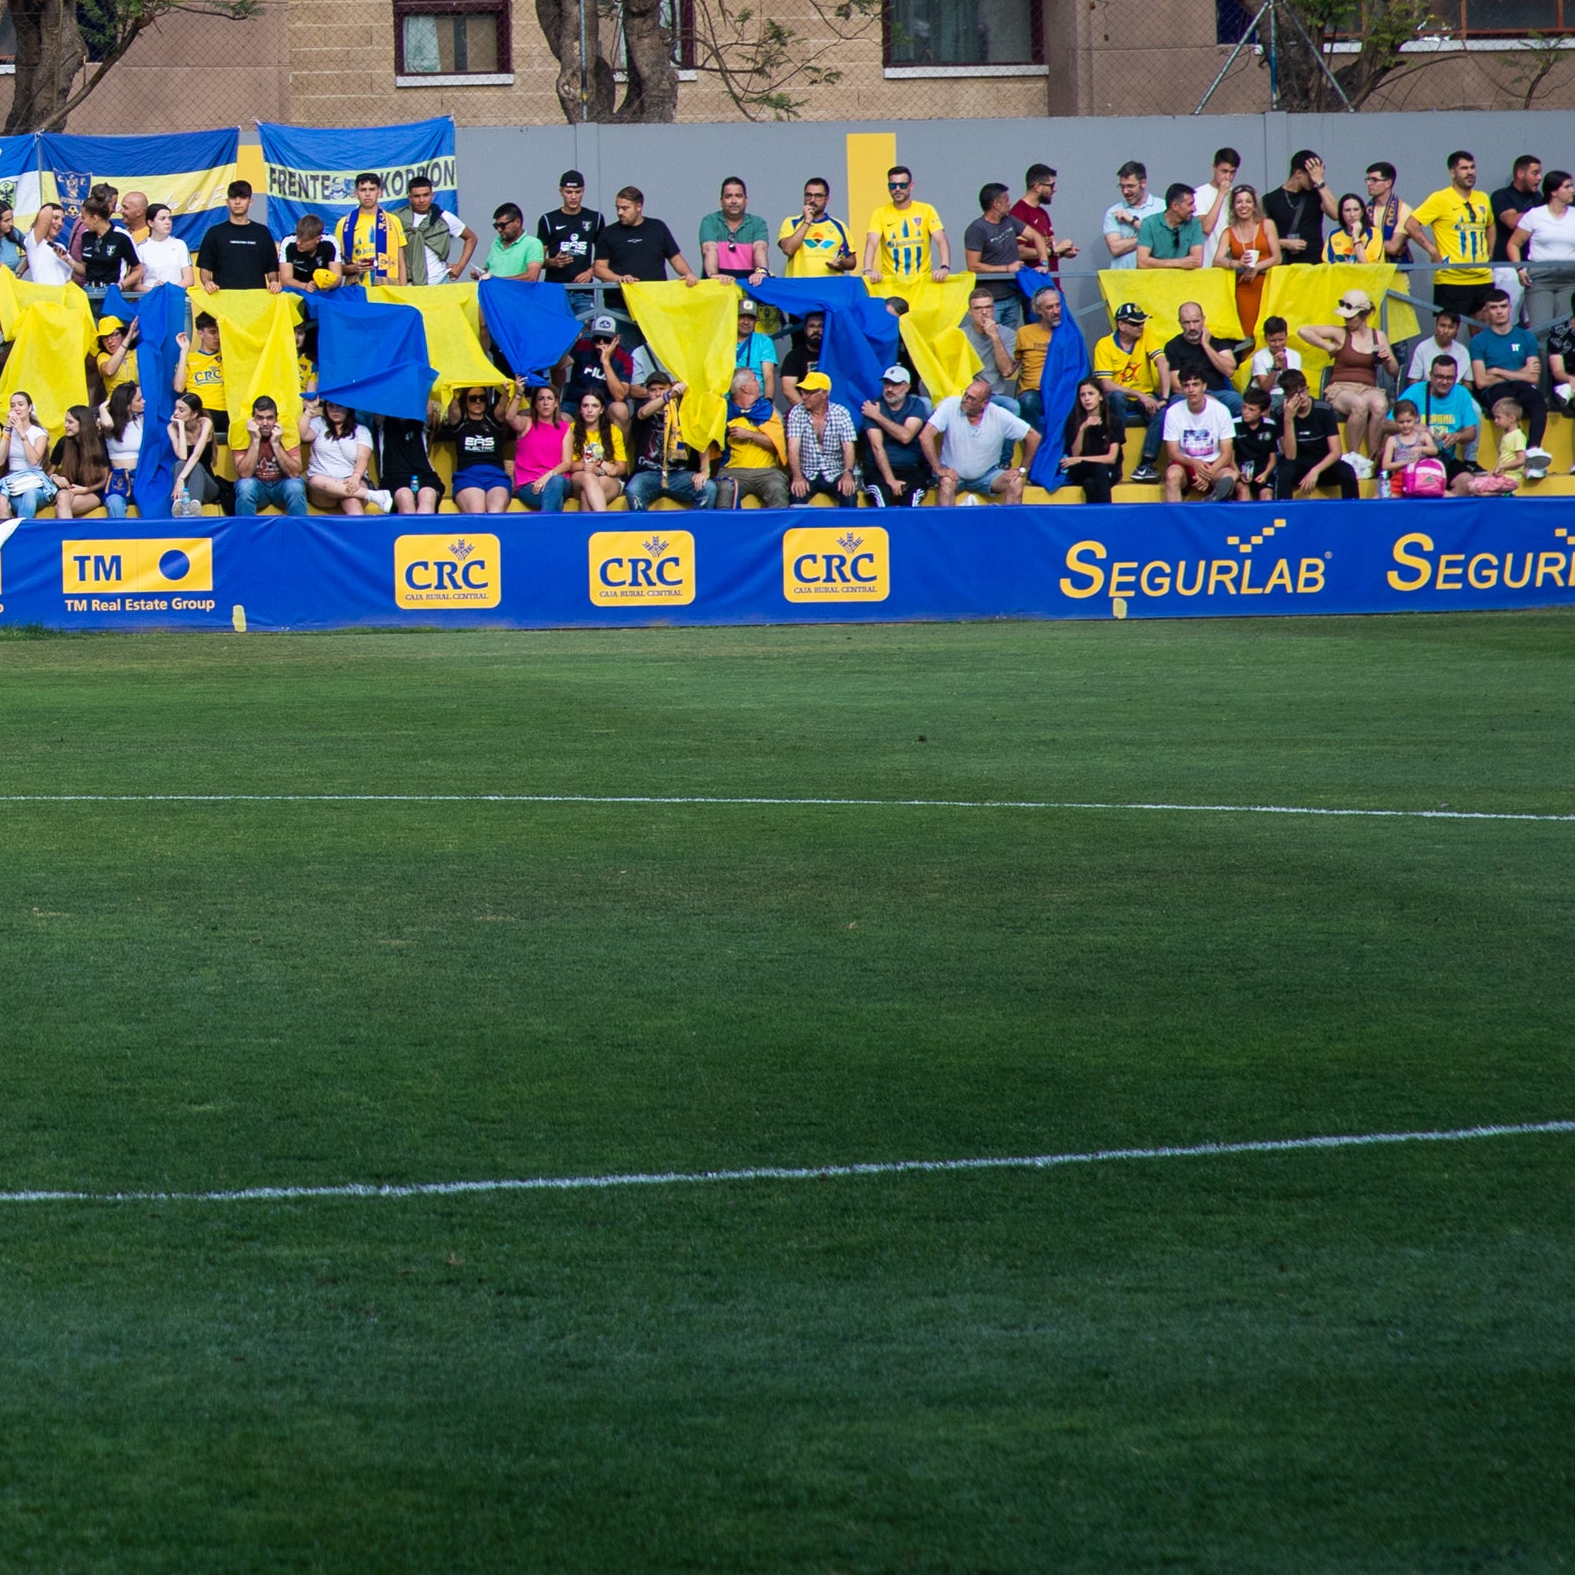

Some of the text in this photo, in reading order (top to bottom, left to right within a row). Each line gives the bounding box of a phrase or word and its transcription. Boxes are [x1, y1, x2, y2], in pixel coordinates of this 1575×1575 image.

[269, 167, 332, 201] FRENTE
[194, 370, 222, 383] CRC
[464, 436, 494, 446] EAS
[73, 555, 122, 581] TM
[599, 557, 683, 588] CRC
[793, 553, 877, 583] CRC
[1059, 540, 1326, 599] SEGURLAB
[1387, 533, 1575, 591] SEGUR
[405, 560, 489, 591] CRC
[452, 592, 489, 600] CENTRAL
[620, 589, 646, 597] RURAL
[647, 589, 683, 597] CENTRAL
[841, 585, 877, 593] CENTRAL
[65, 597, 215, 613] TM Real Estate Group
